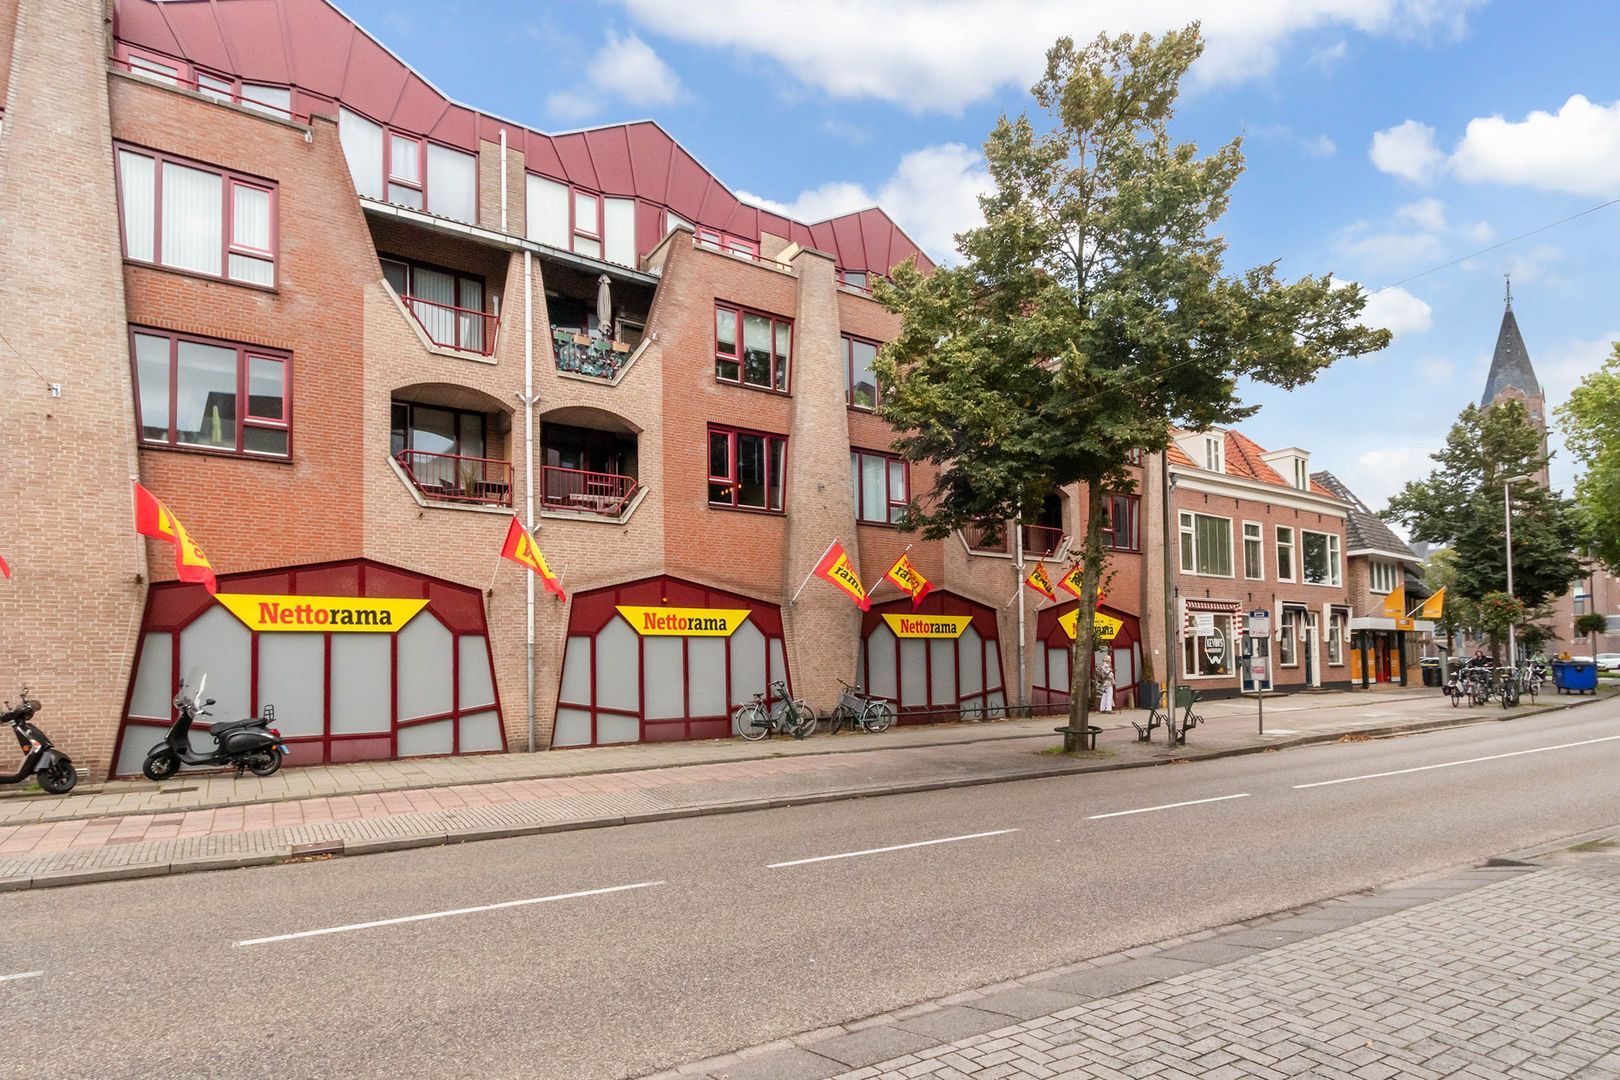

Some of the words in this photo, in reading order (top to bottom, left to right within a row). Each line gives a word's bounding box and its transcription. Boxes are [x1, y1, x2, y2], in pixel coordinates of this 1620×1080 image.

[258, 602, 393, 625] Nettorama
[643, 612, 728, 631] Nettorama
[900, 618, 957, 634] Nettorama
